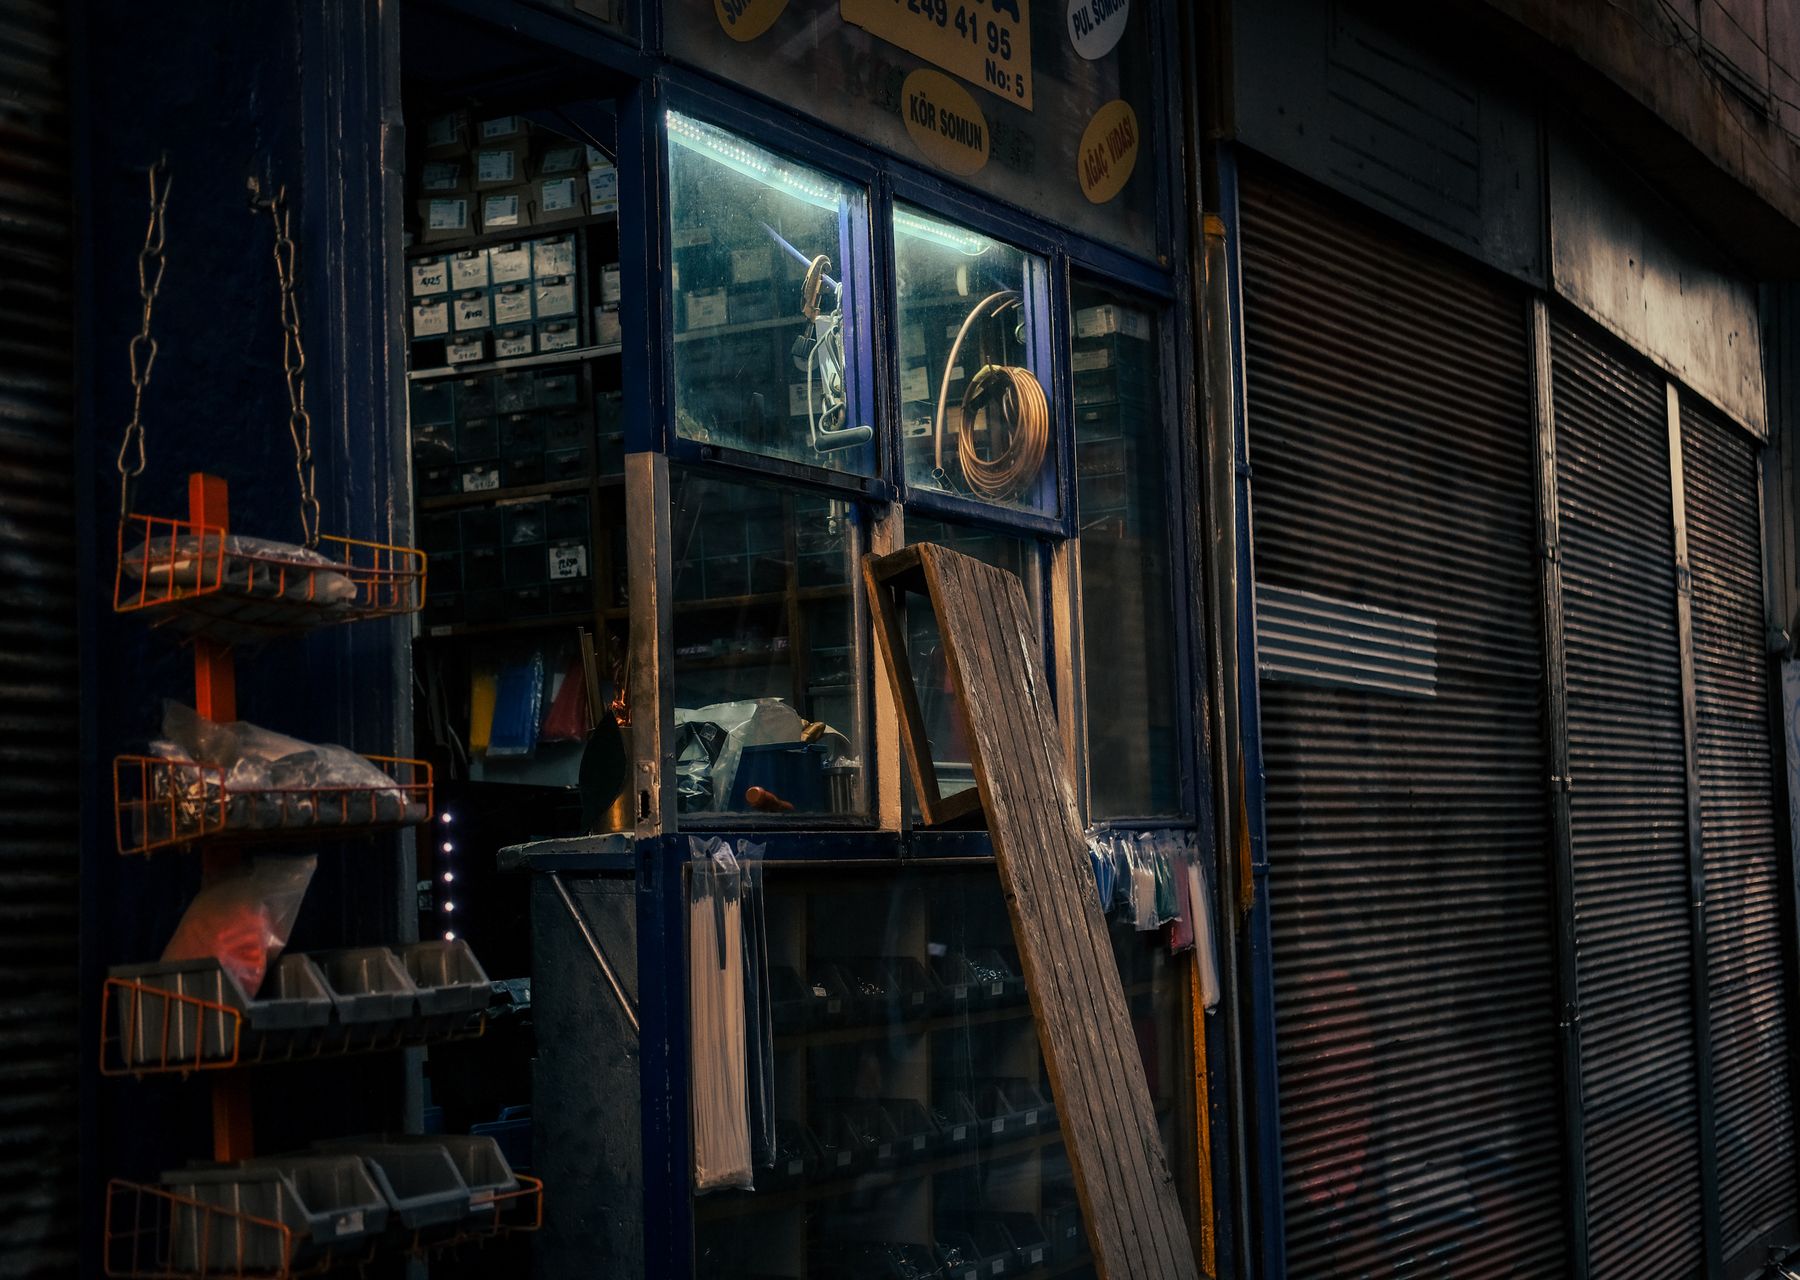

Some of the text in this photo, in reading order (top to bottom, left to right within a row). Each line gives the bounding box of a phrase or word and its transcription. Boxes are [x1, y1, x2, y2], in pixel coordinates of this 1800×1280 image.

[955, 5, 978, 44] 41
[987, 21, 1012, 61] 95
[1072, 0, 1126, 41] PUL SOM
[985, 58, 1025, 98] No: 5
[910, 90, 983, 152] KÖR SOMUN
[1083, 114, 1136, 191] AĞAÇ VİDASI
